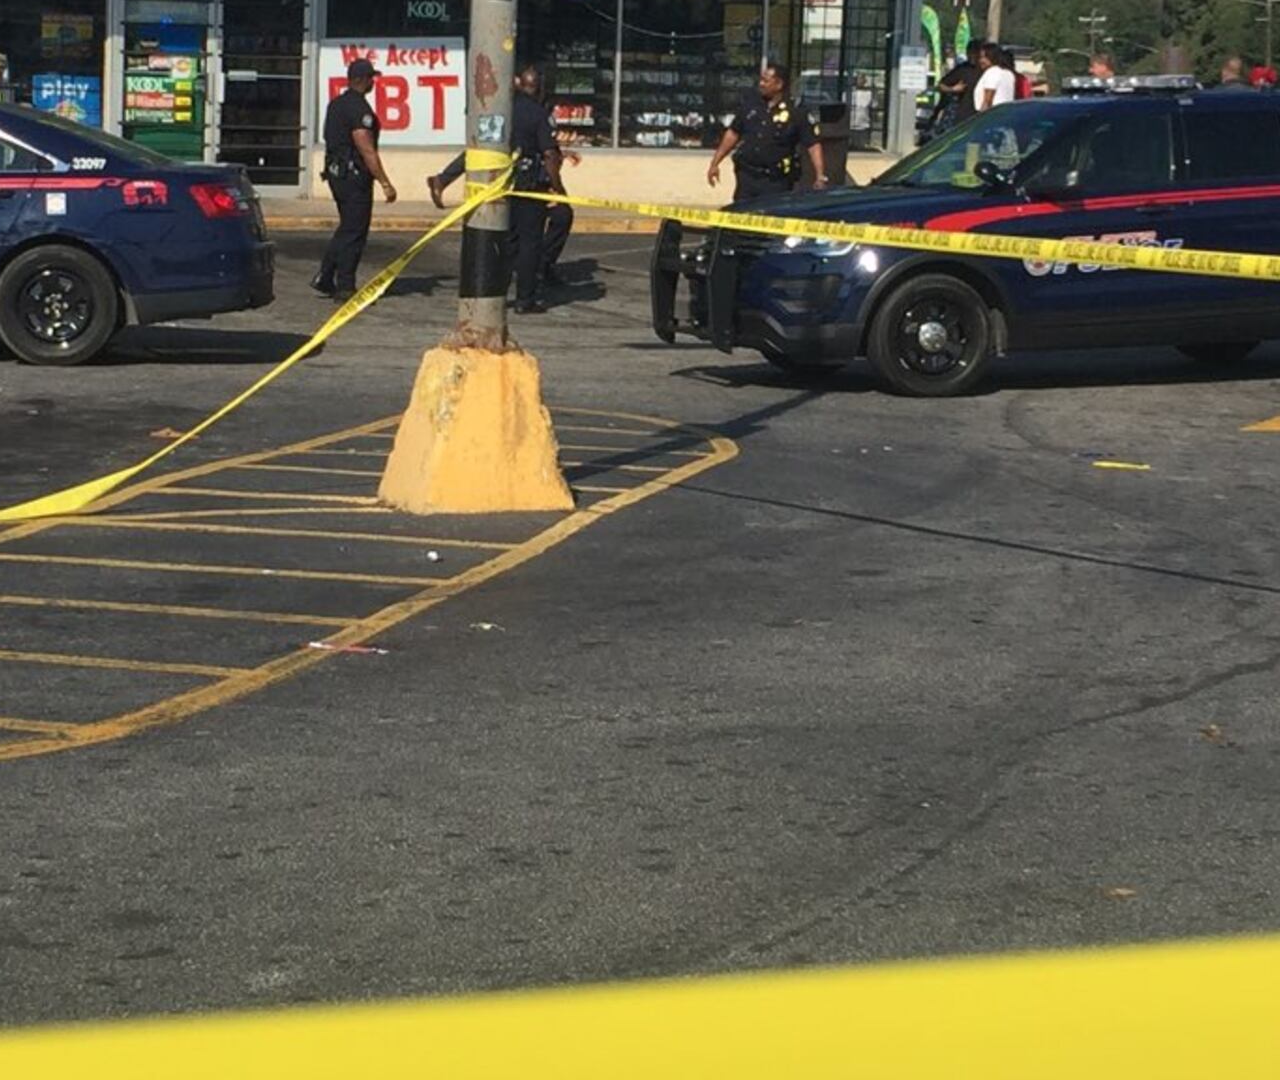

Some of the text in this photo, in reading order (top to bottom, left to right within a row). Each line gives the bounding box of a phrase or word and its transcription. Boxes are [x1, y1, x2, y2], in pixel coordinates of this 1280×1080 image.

[407, 1, 449, 19] KOOL
[340, 44, 449, 69] We Accept
[41, 80, 90, 100] play
[127, 77, 167, 92] KOOL
